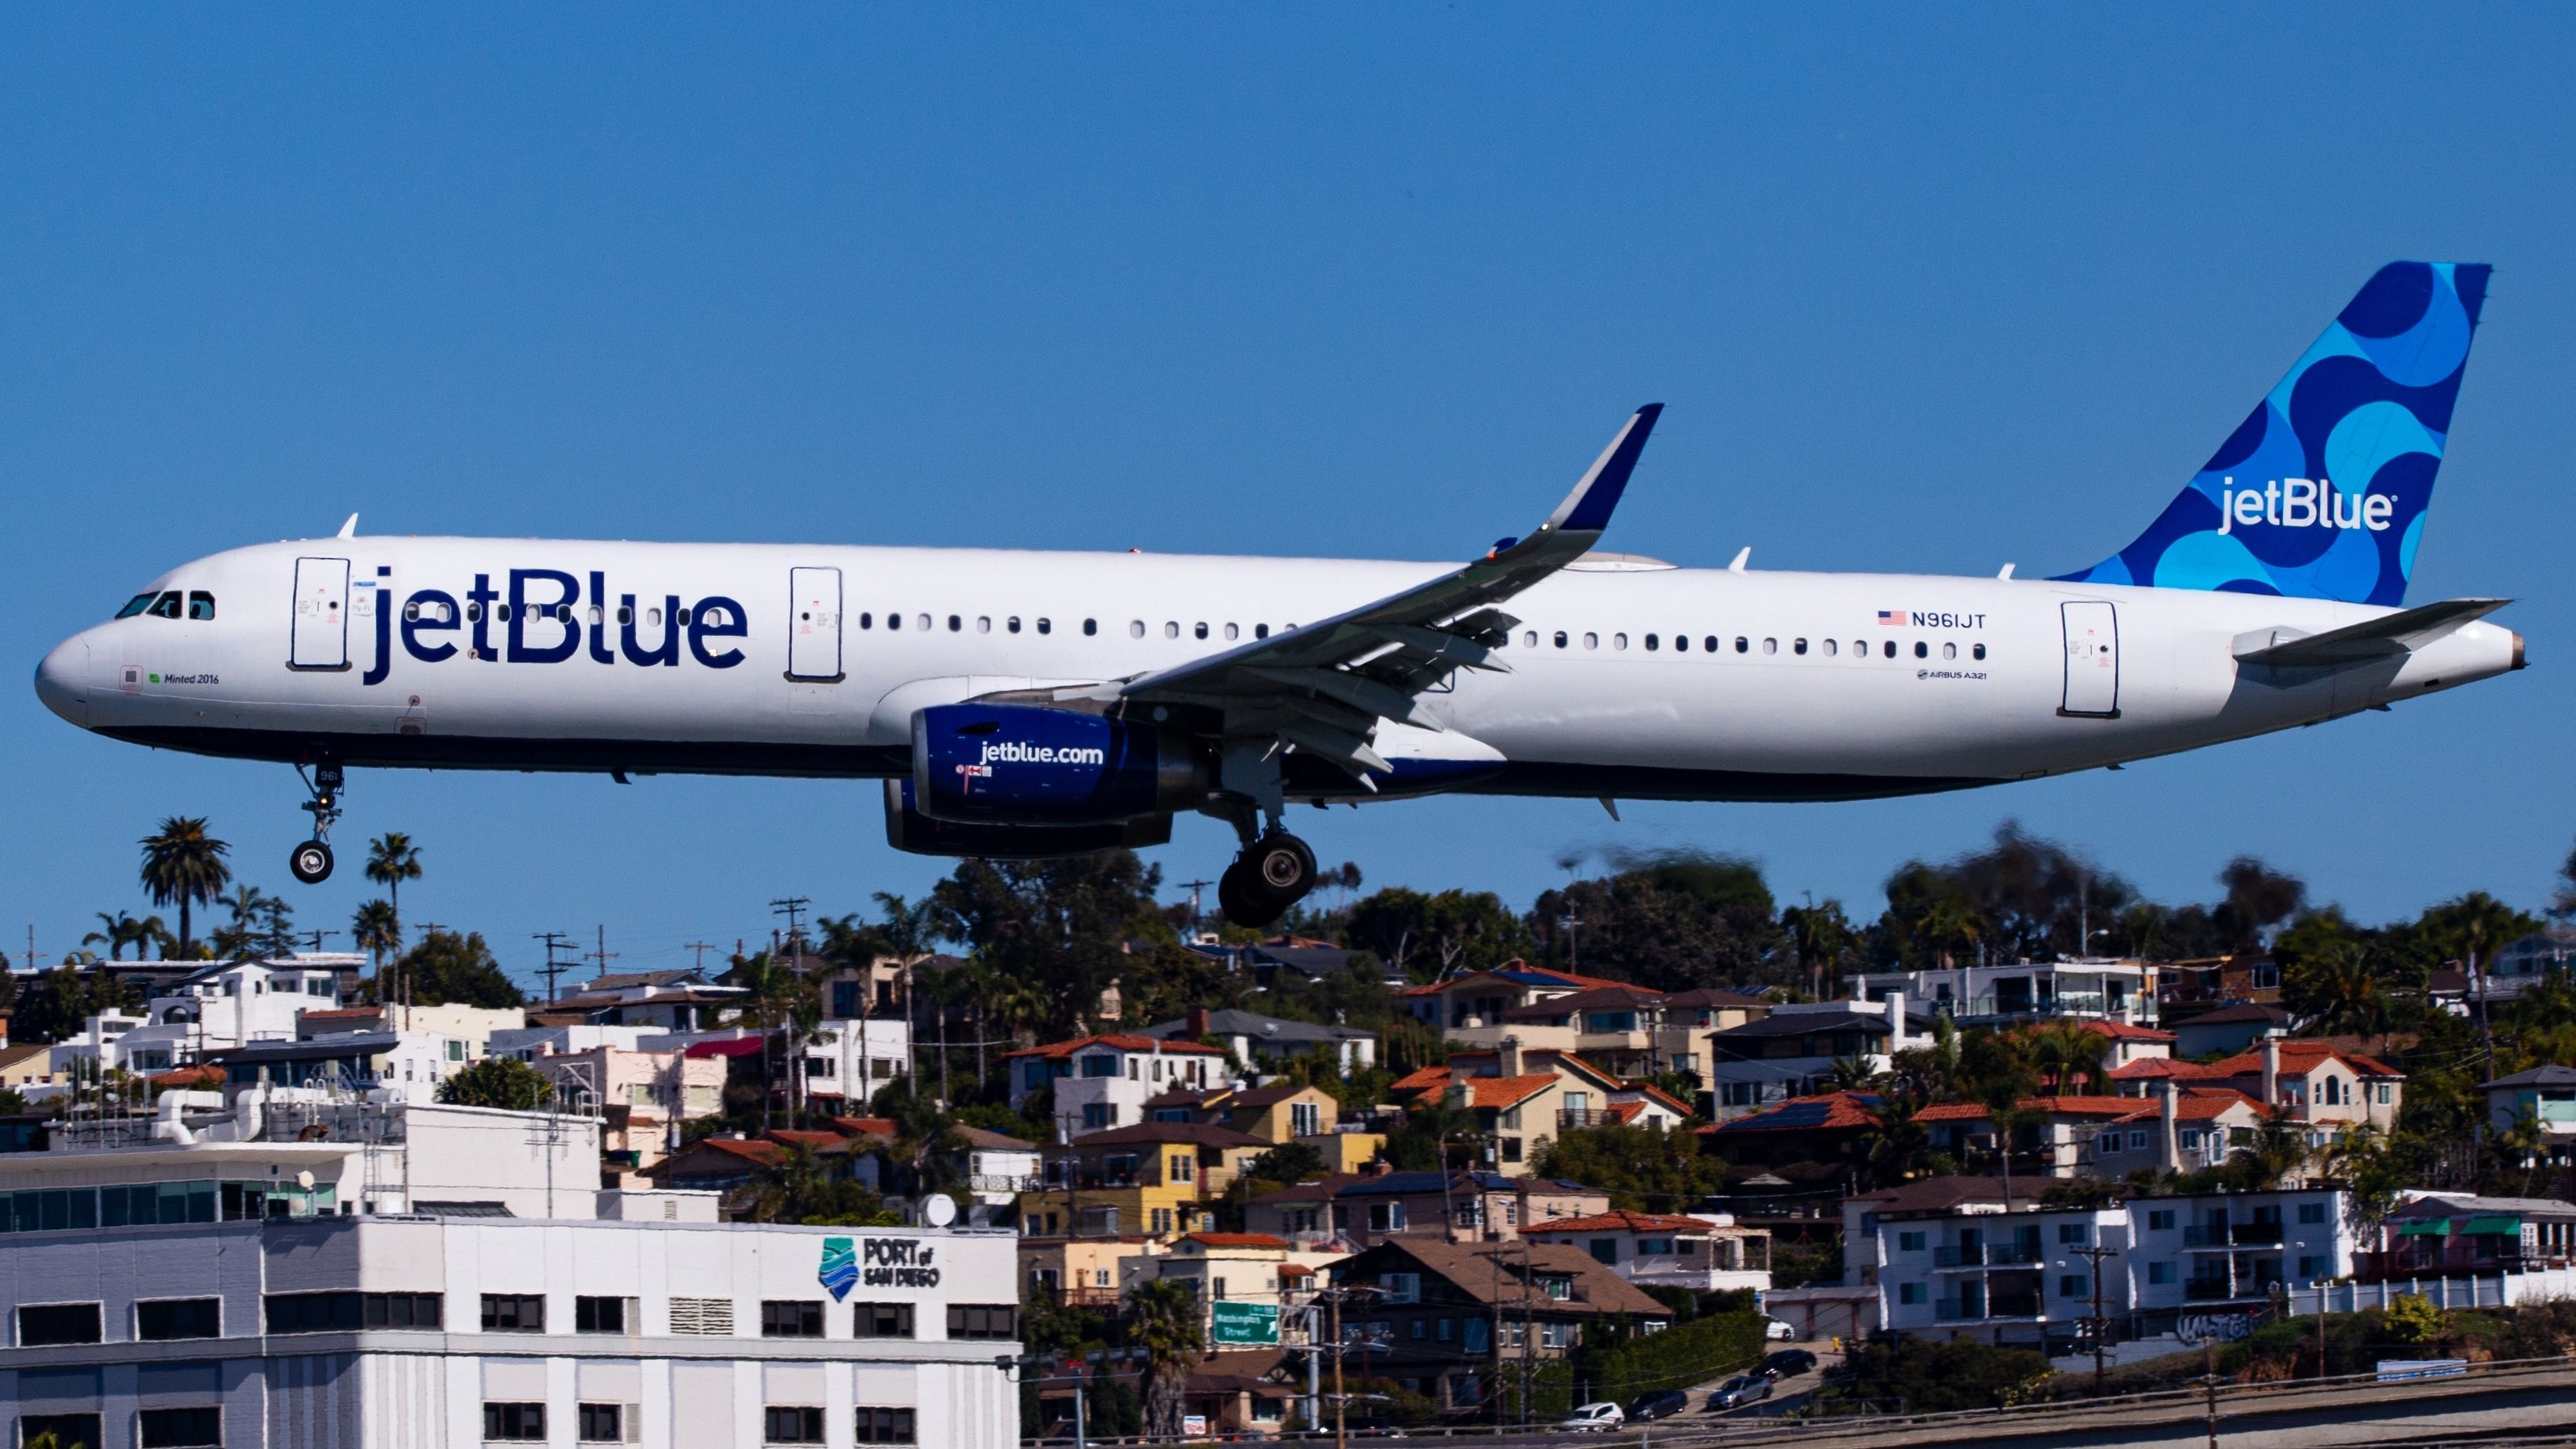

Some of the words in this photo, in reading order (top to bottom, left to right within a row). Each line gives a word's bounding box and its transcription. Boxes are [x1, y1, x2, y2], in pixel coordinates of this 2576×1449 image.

[363, 566, 748, 686] jetBlue
[1913, 612, 1986, 629] N961JT
[164, 674, 195, 684] Minted
[197, 674, 219, 685] 2016
[1930, 671, 1962, 679] AIRBUS
[979, 741, 1104, 765] jetblue.com
[320, 770, 338, 781] 961
[863, 1238, 920, 1266] PORT
[919, 1247, 934, 1266] of
[863, 1268, 893, 1287] SAN
[896, 1268, 941, 1288] DIEGO
[1223, 1326, 1252, 1337] Street
